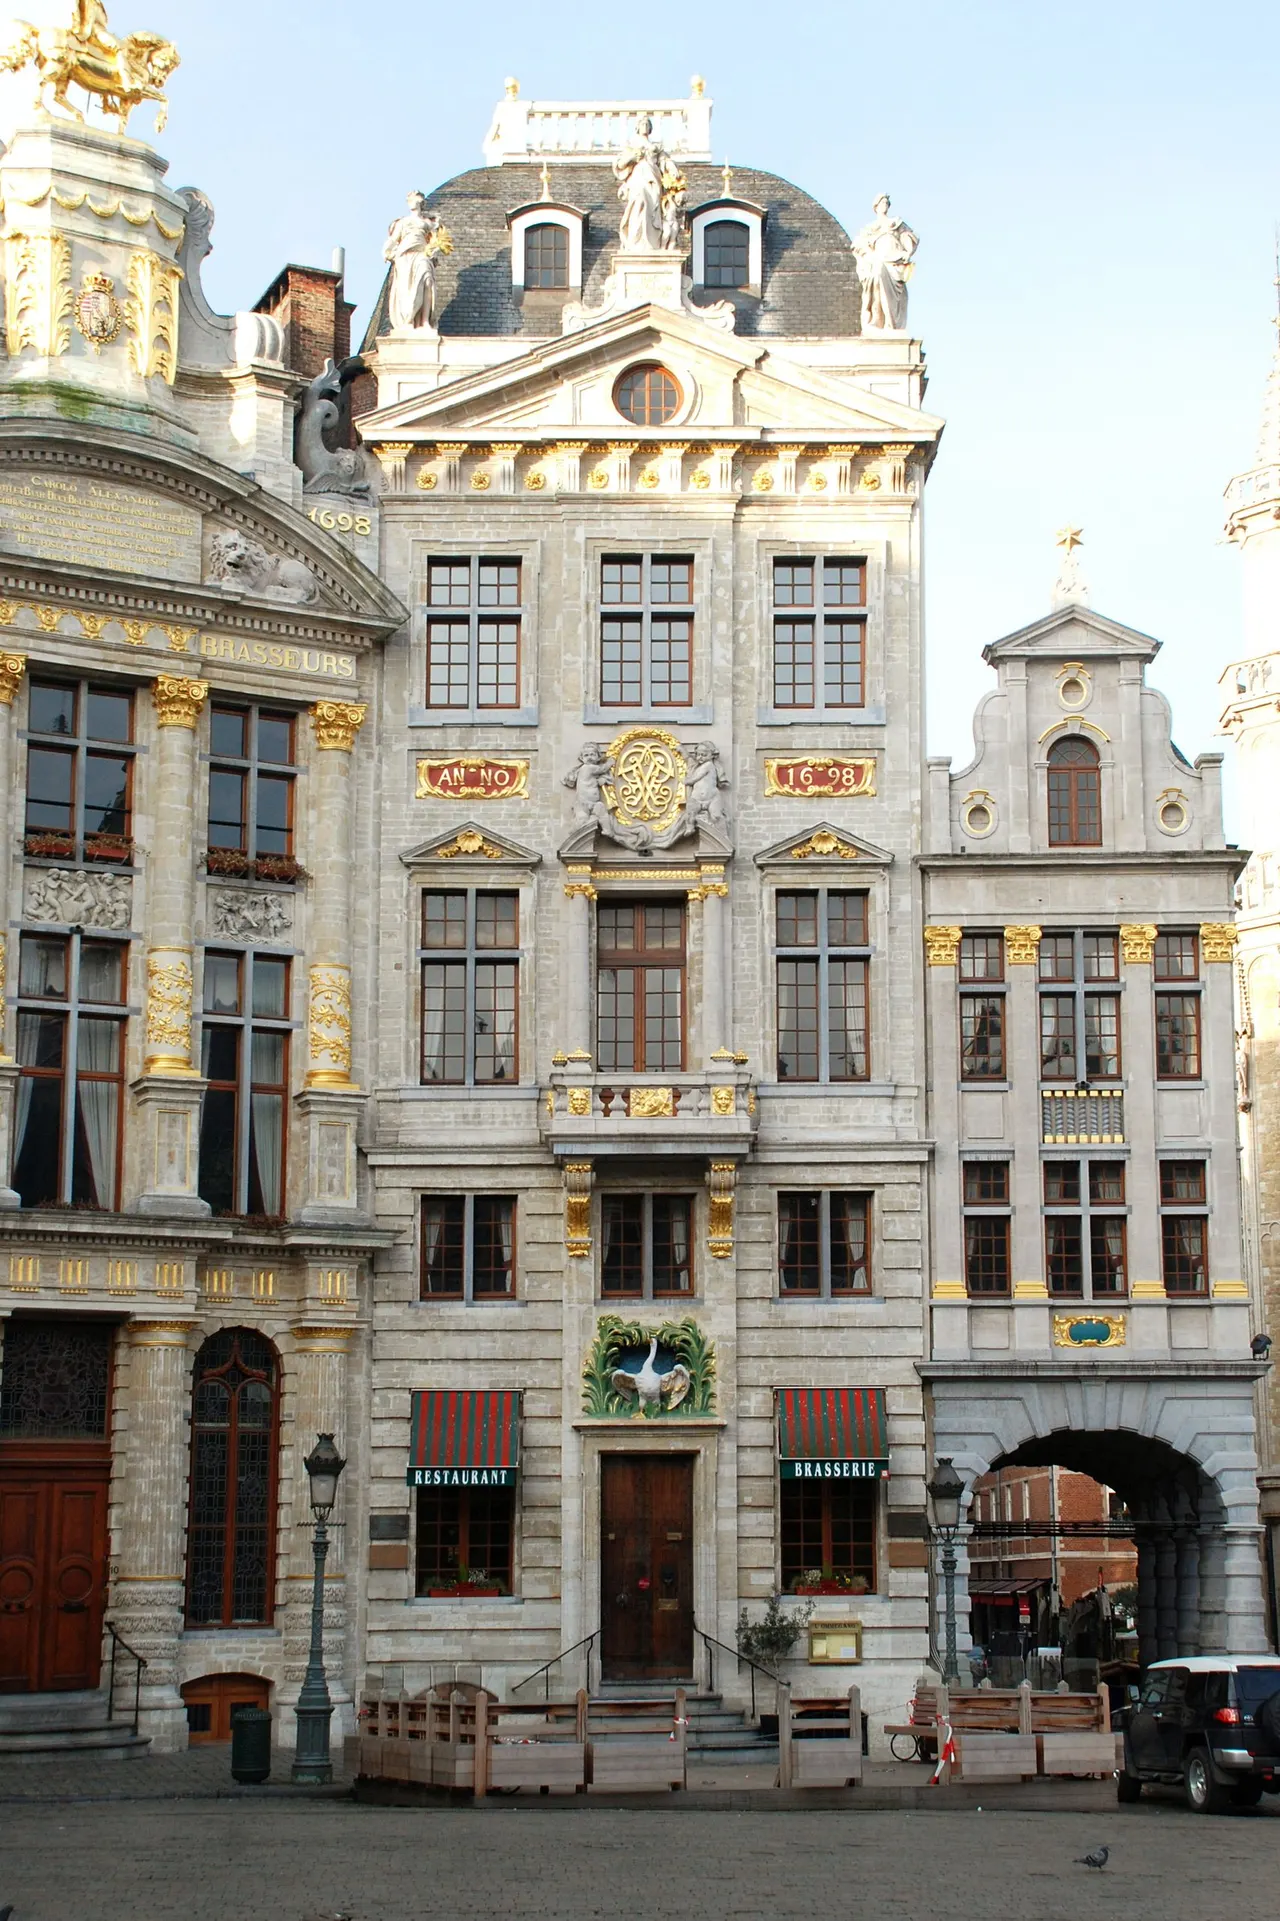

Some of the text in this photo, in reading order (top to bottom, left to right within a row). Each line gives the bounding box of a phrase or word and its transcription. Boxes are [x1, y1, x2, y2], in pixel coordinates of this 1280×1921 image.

[307, 507, 372, 536] 1698
[200, 635, 353, 677] BRASSEURS
[415, 1470, 507, 1485] RESTAURANT
[795, 1462, 876, 1477] BRASSERIE
